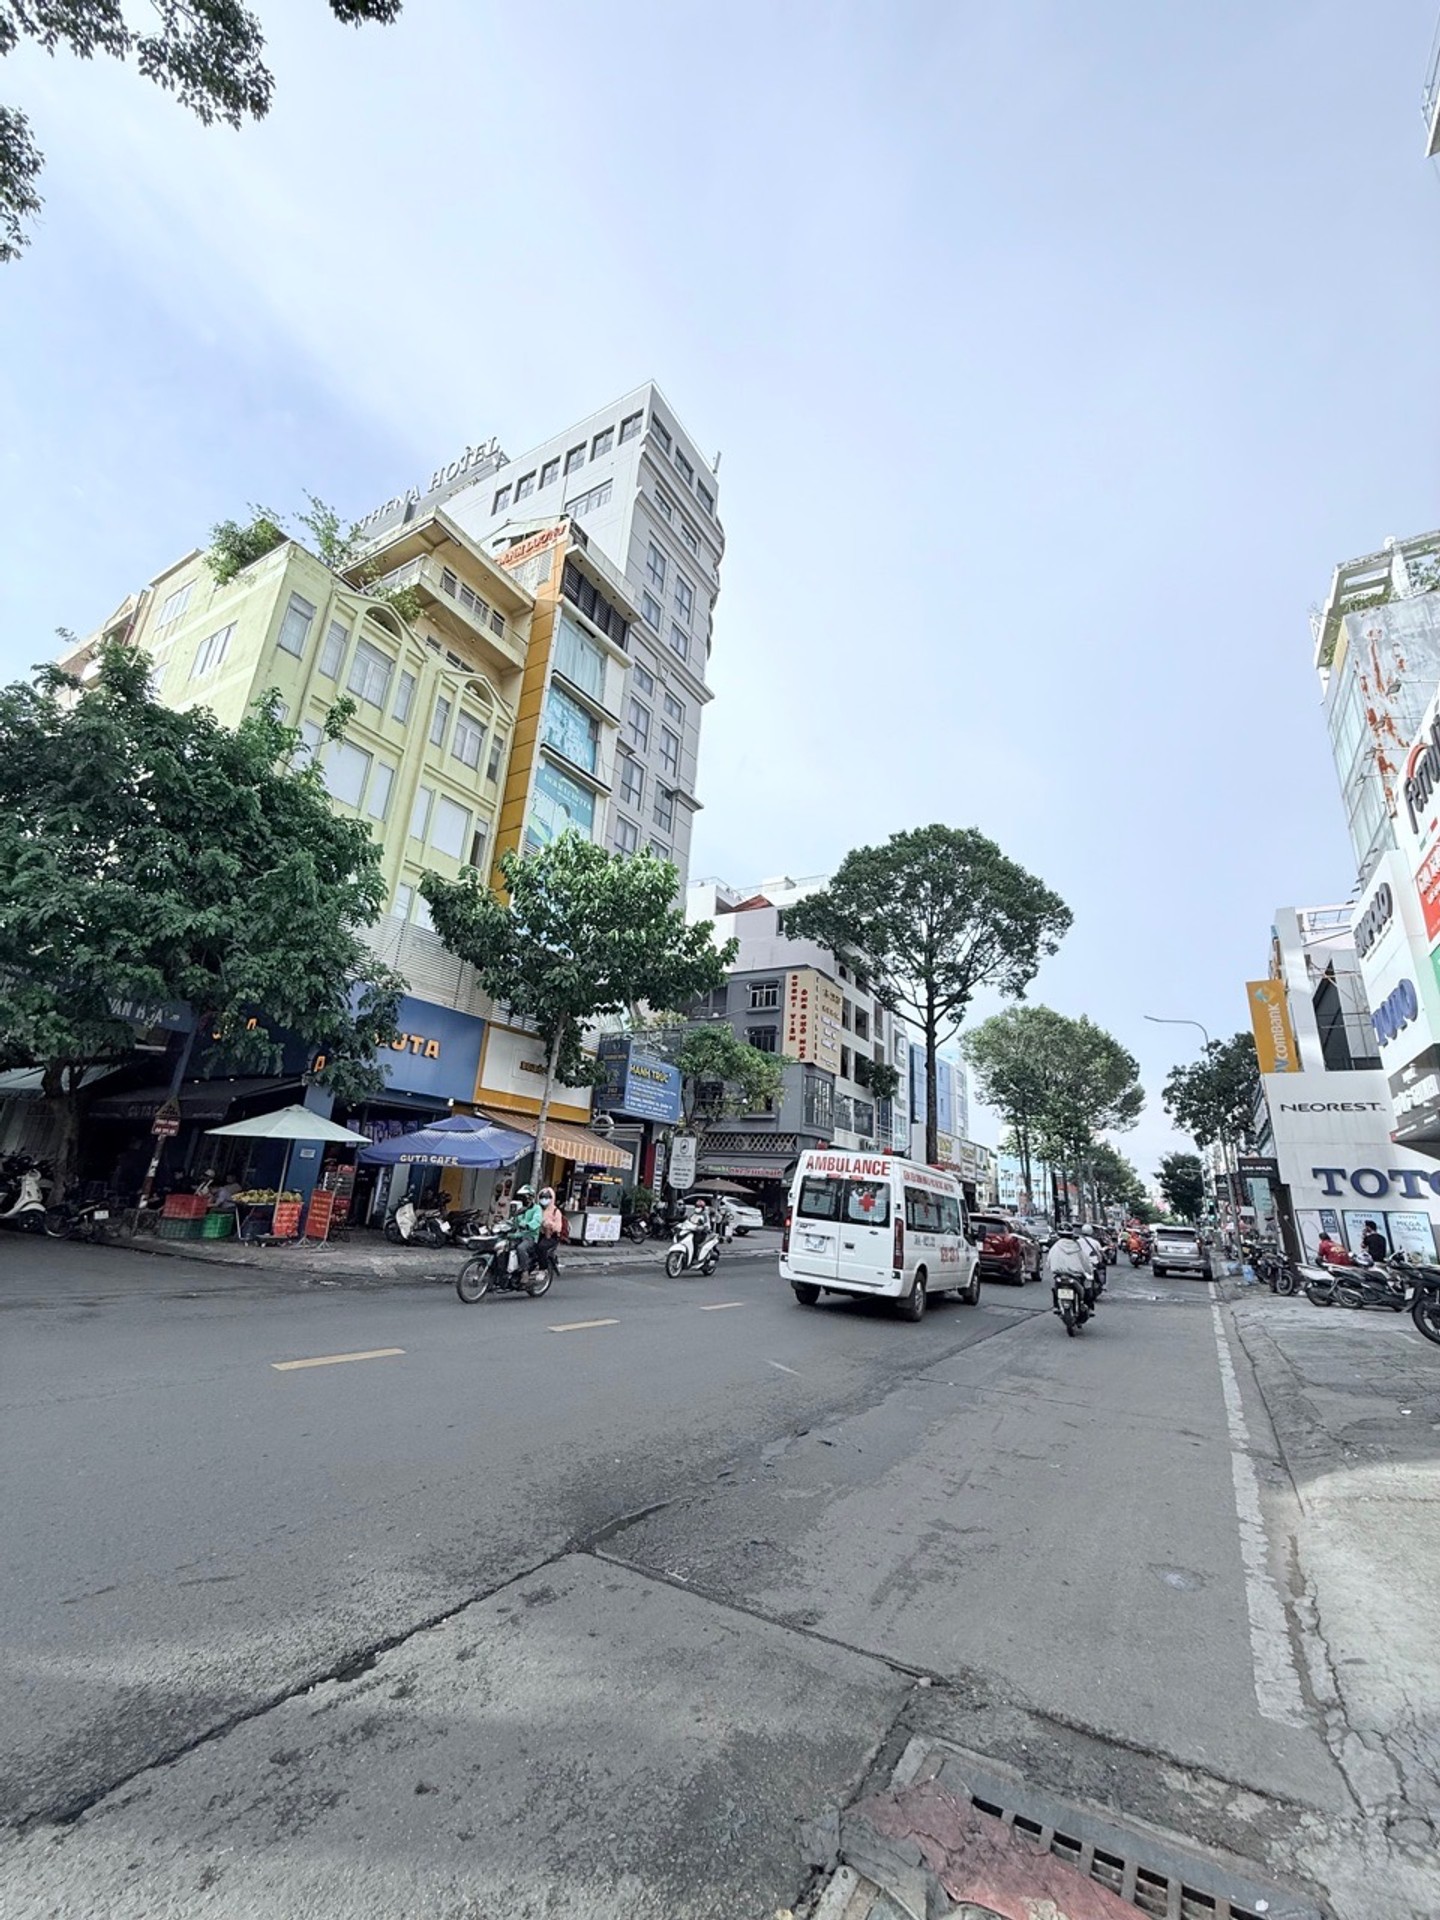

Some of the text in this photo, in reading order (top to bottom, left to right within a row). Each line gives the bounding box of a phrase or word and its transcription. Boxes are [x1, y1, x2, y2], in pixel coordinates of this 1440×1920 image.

[427, 436, 501, 493] HOTEL
[399, 1154, 428, 1163] GUTA
[806, 1155, 892, 1177] AMBULANCE
[1312, 1167, 1440, 1200] TOT
